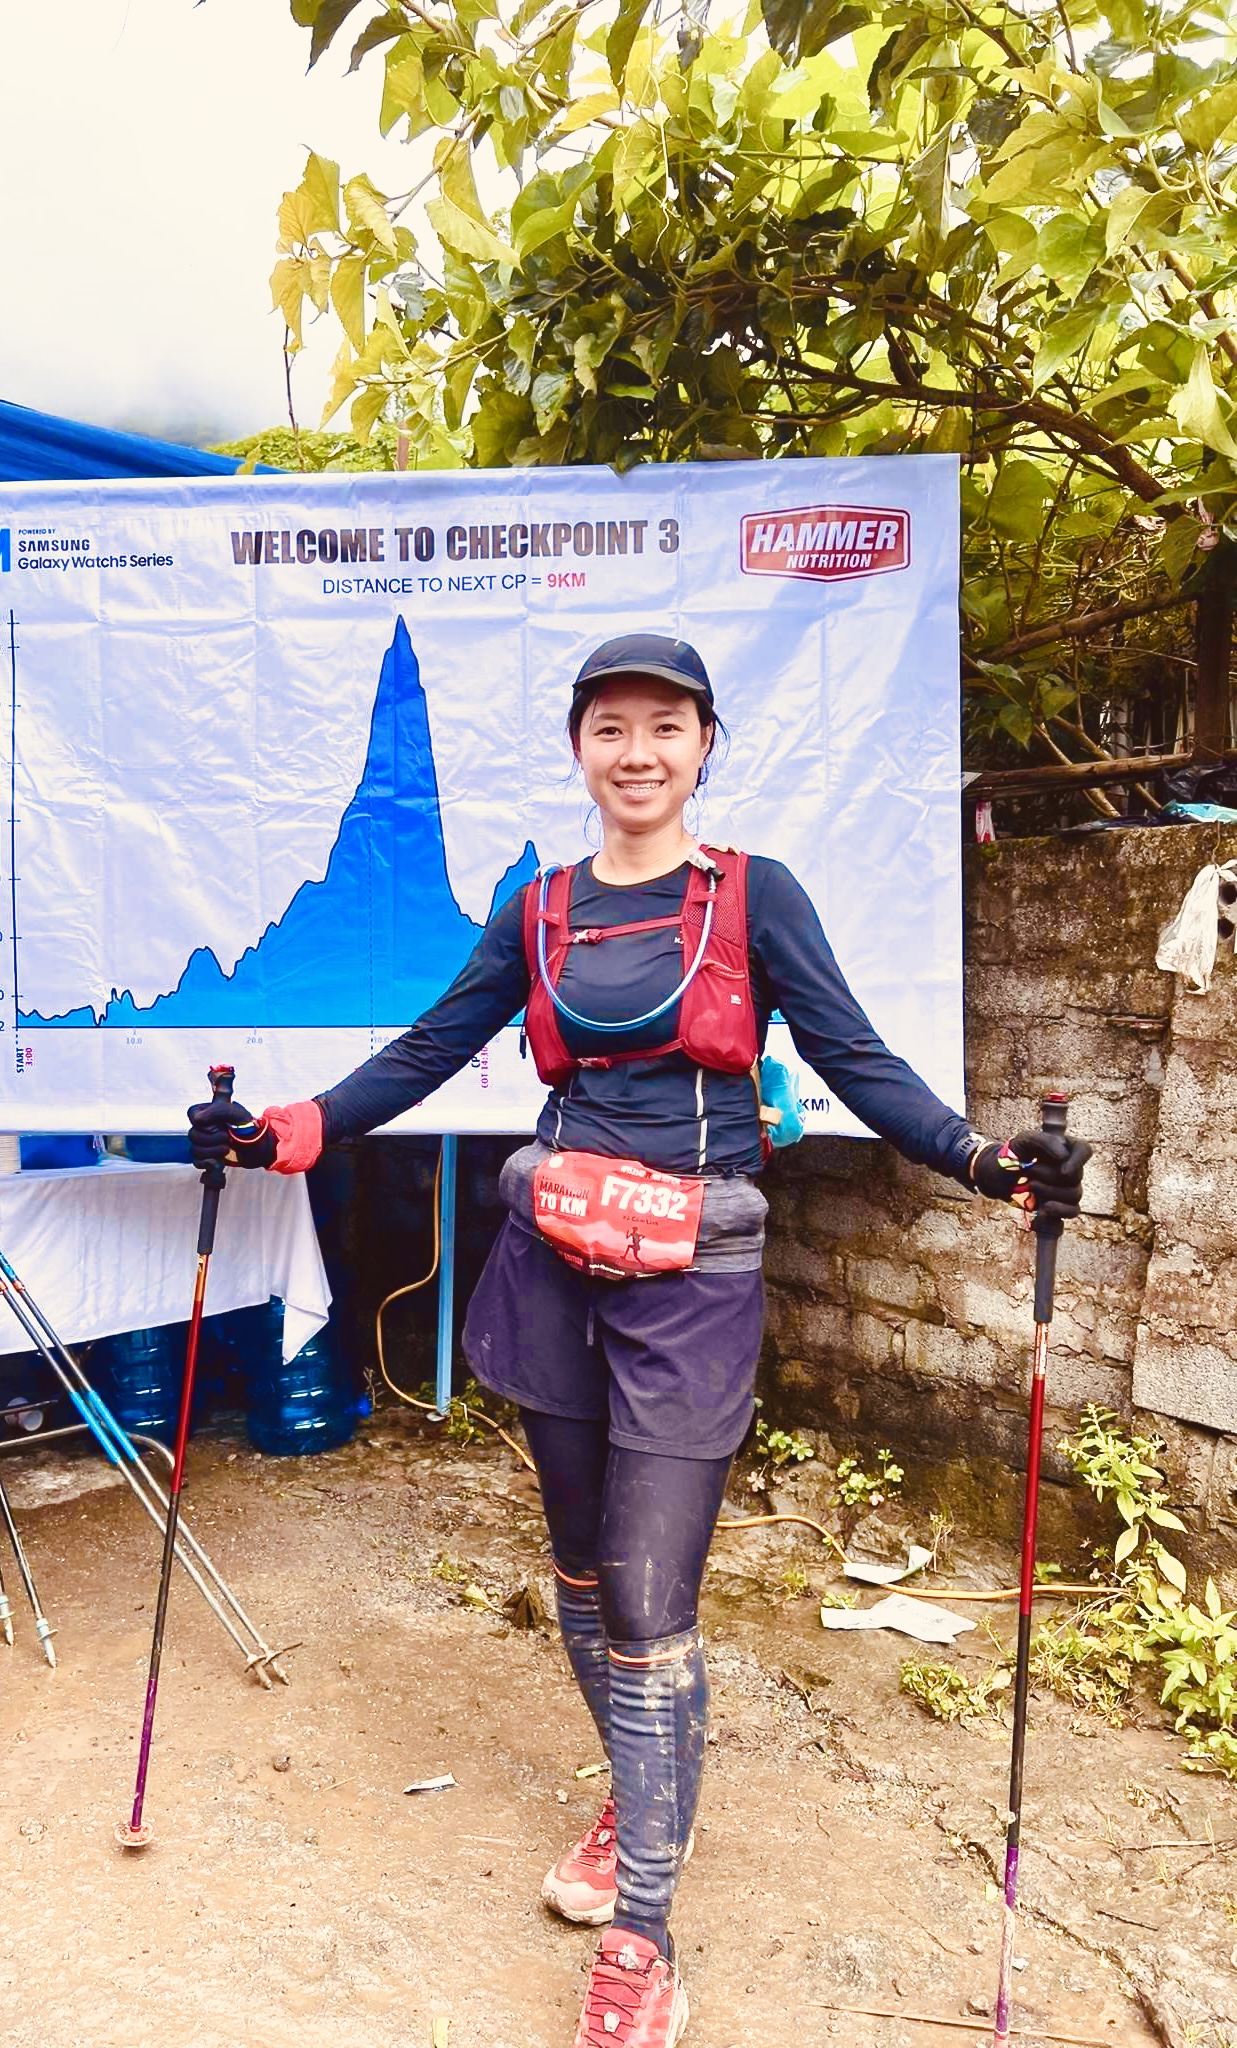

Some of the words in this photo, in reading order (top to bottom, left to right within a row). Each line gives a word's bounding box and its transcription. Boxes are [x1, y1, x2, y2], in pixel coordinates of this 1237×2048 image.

[18, 539, 91, 552] SAMSUNG
[230, 528, 385, 565] WELCOME
[394, 526, 435, 562] TO
[446, 519, 649, 561] CHECKPOINT
[658, 518, 680, 553] 3
[750, 520, 899, 553] HAMMER
[17, 556, 70, 571] Galaxy
[71, 555, 127, 568] Watch5
[130, 553, 174, 567] Series
[786, 553, 872, 568] NUTRITION
[323, 578, 413, 594] DISTANCE
[417, 577, 443, 593] TO
[447, 575, 497, 592] NEXT
[501, 574, 527, 590] CP
[547, 572, 586, 588] 9KM
[16, 1047, 25, 1073] START
[539, 1191, 557, 1210] 70
[560, 1195, 588, 1217] KM
[601, 1175, 688, 1221] F7332
